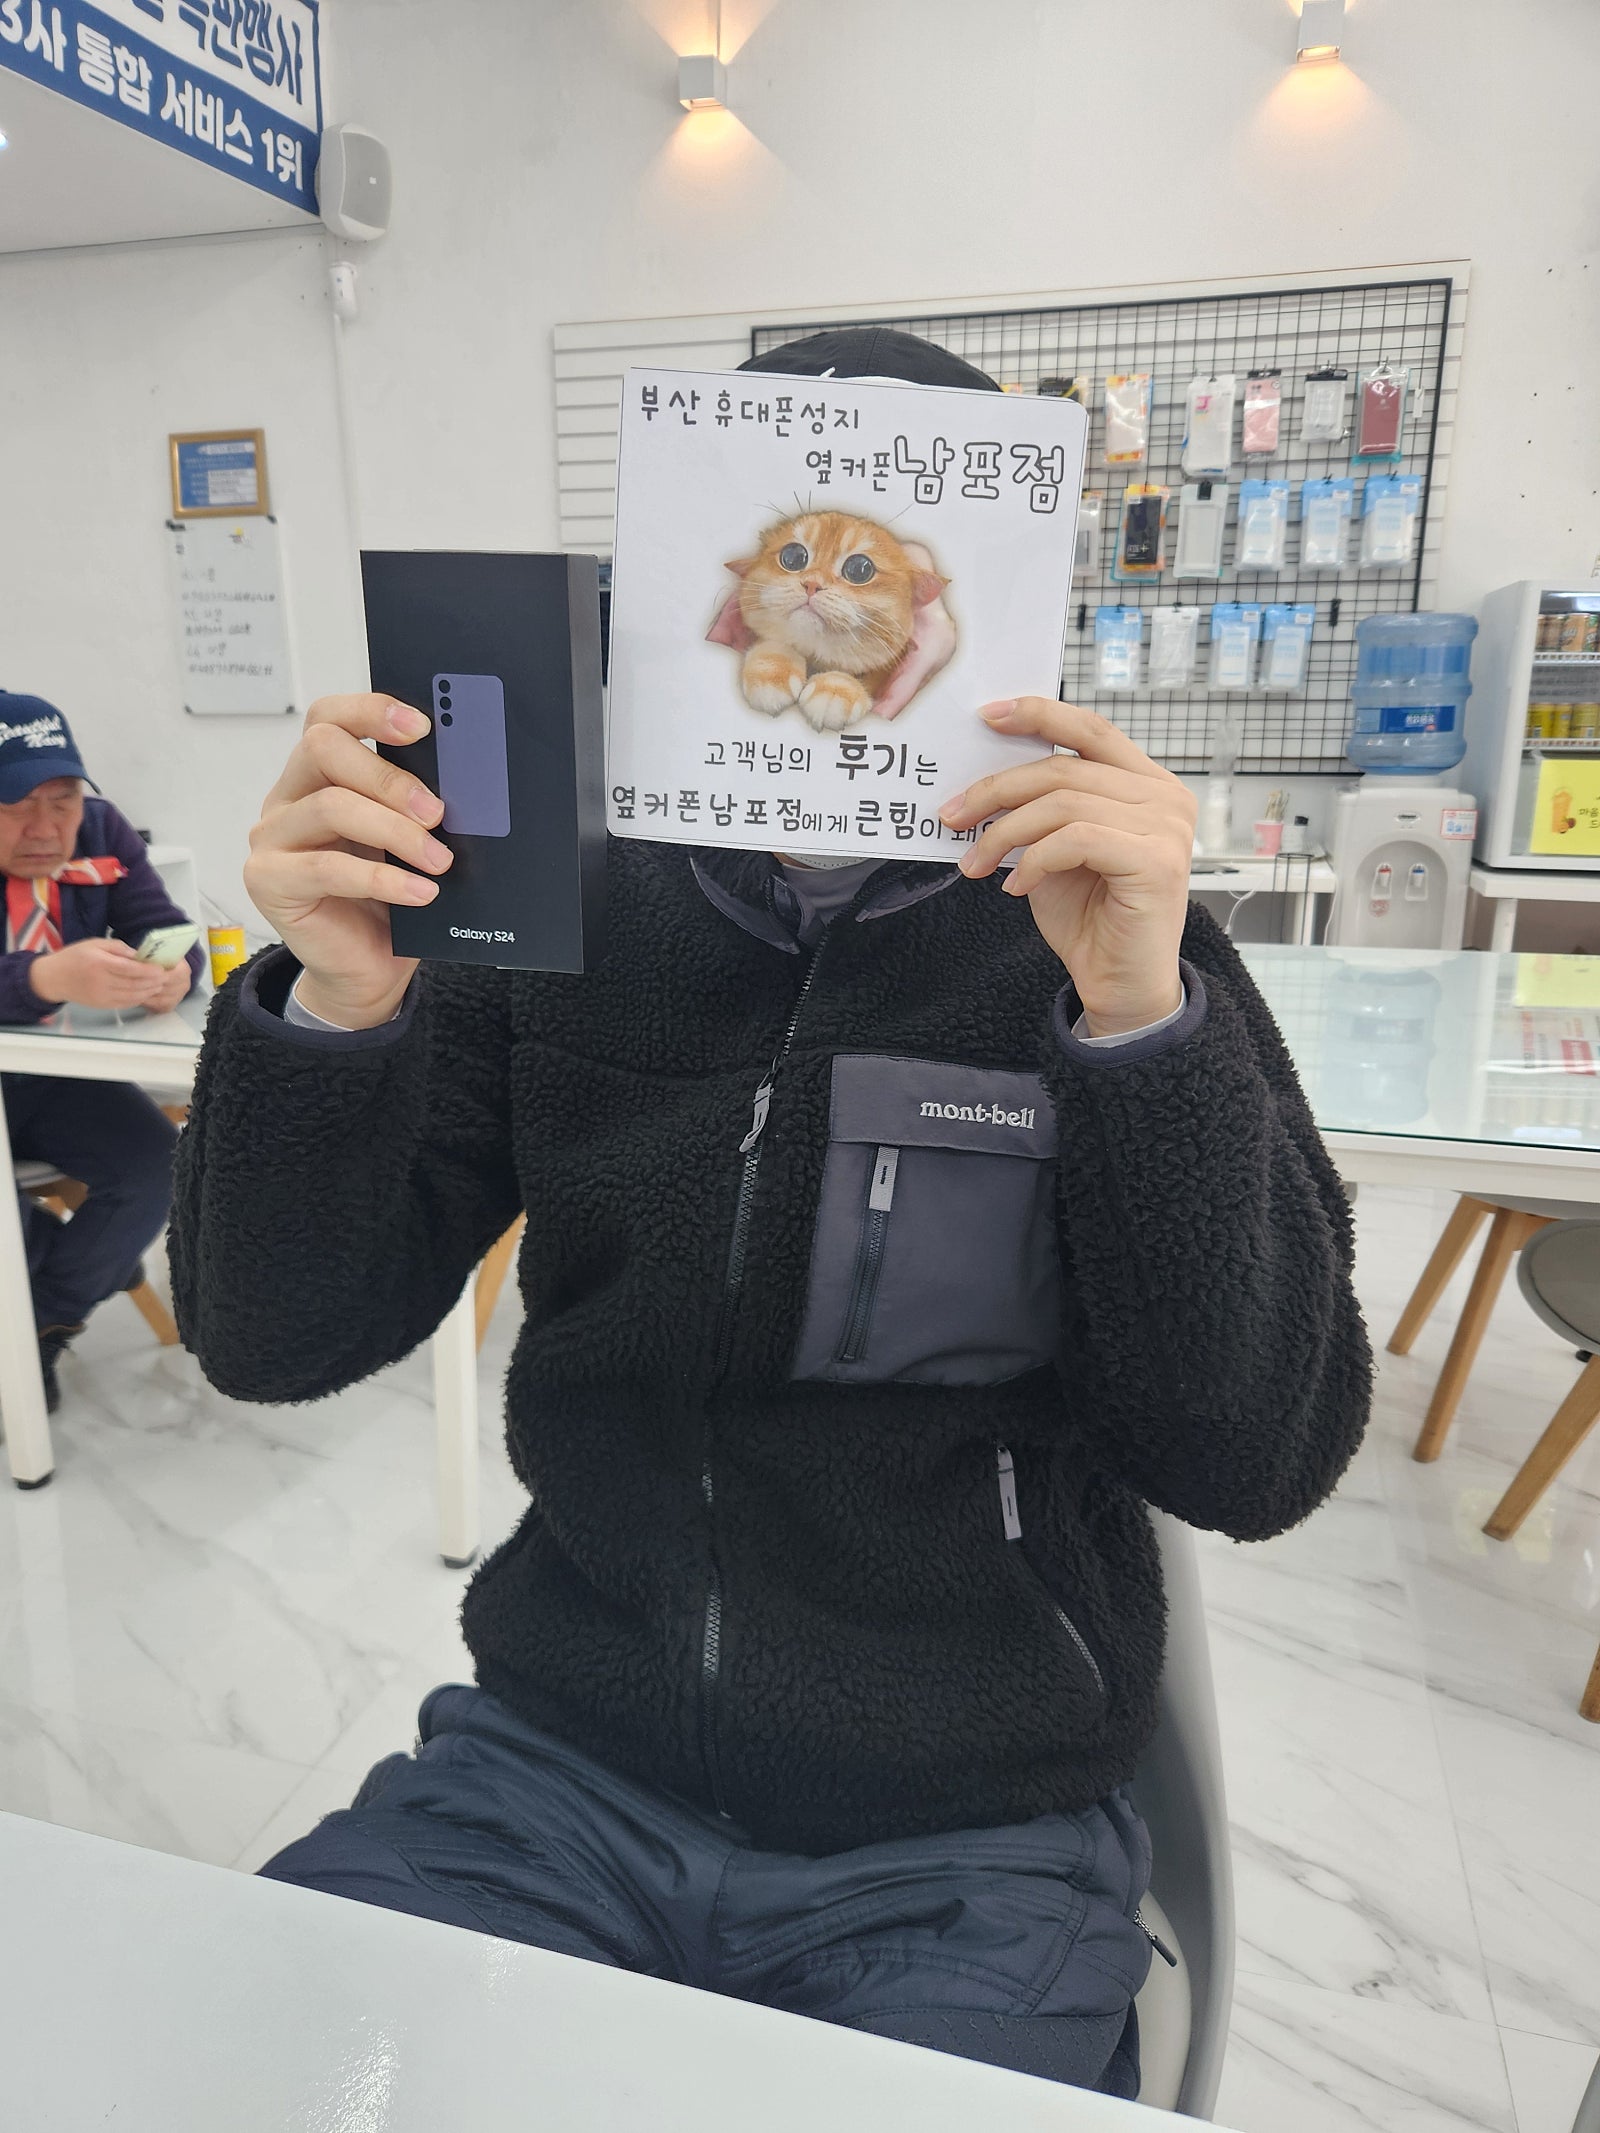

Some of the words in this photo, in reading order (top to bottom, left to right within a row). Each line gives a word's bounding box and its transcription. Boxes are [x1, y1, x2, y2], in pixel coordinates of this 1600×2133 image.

[0, 0, 68, 72] 3사
[76, 21, 153, 116] 통합
[160, 72, 254, 166] 서비스
[261, 128, 304, 191] 1위
[641, 385, 700, 426] 부산
[714, 390, 859, 438] 휴대폰성지
[704, 741, 811, 773] 고객님의
[836, 734, 938, 786] 후기는
[449, 926, 493, 944] Galaxy
[494, 930, 516, 943] S24
